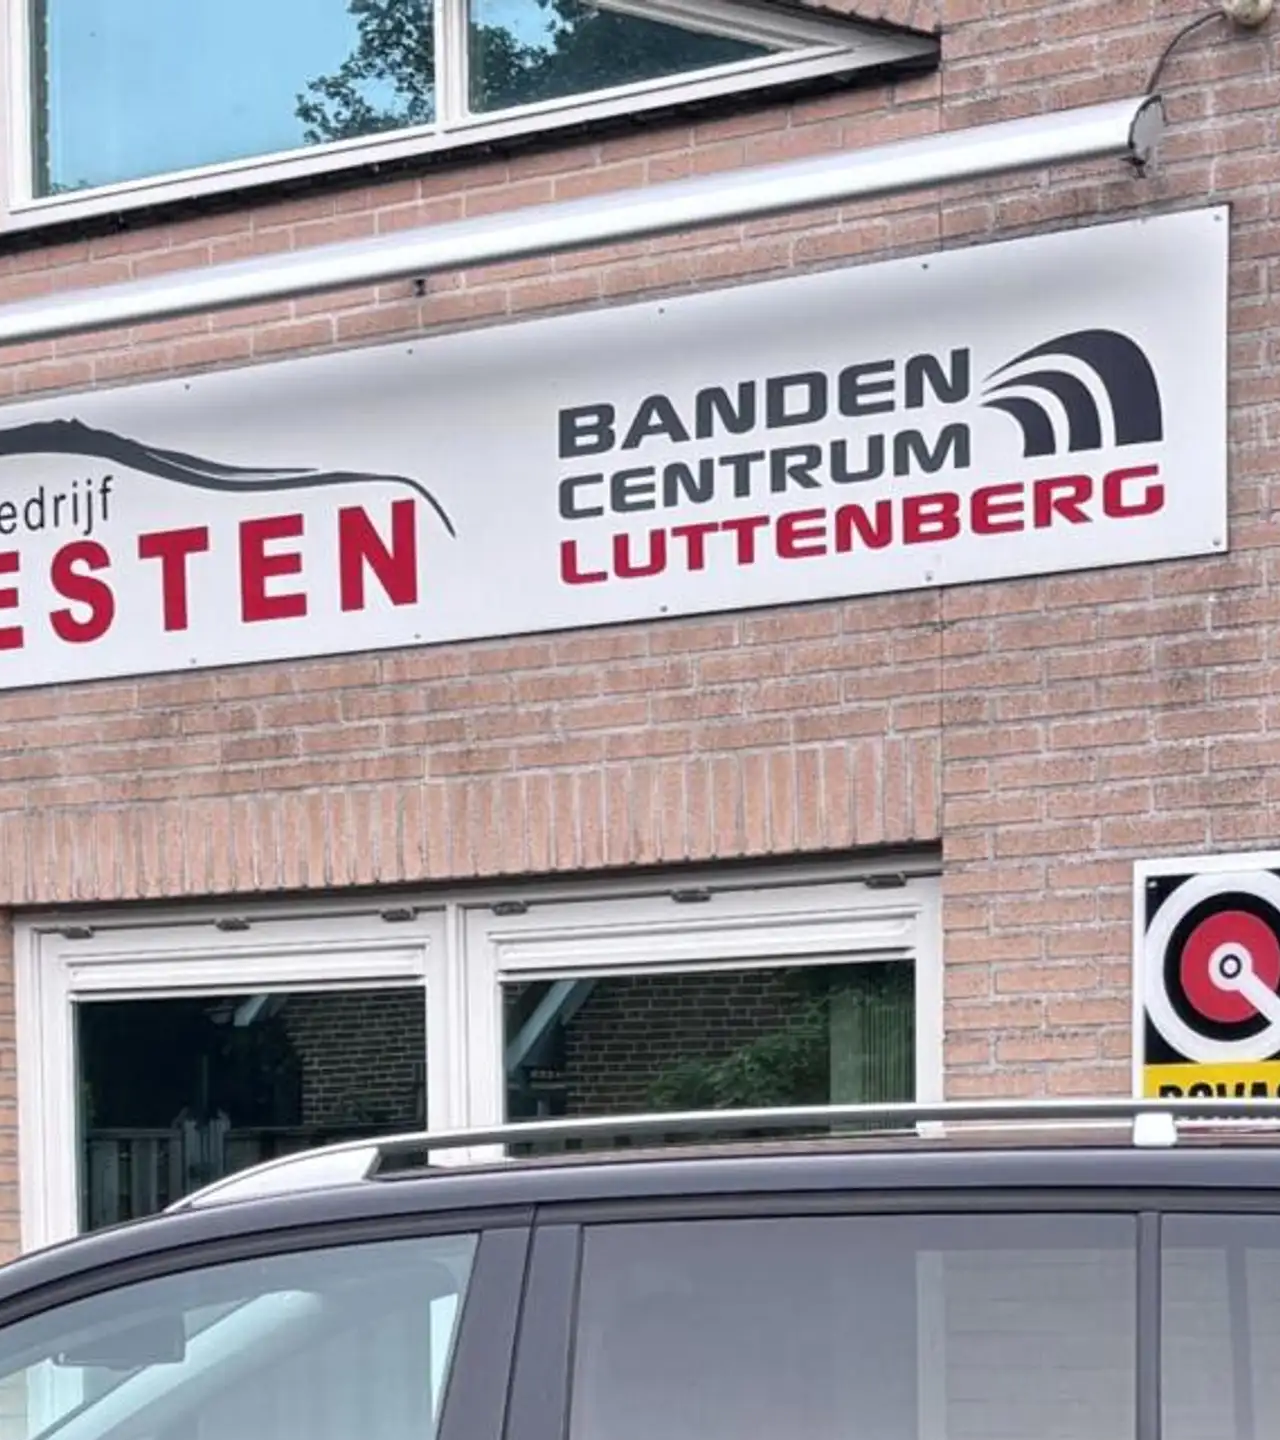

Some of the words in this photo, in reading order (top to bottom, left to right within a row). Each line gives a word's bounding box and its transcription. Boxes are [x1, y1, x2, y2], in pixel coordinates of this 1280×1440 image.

[558, 347, 971, 459] BANDEN
[558, 423, 971, 519] CENTRUM
[560, 465, 1164, 585] LUTTENBERG
